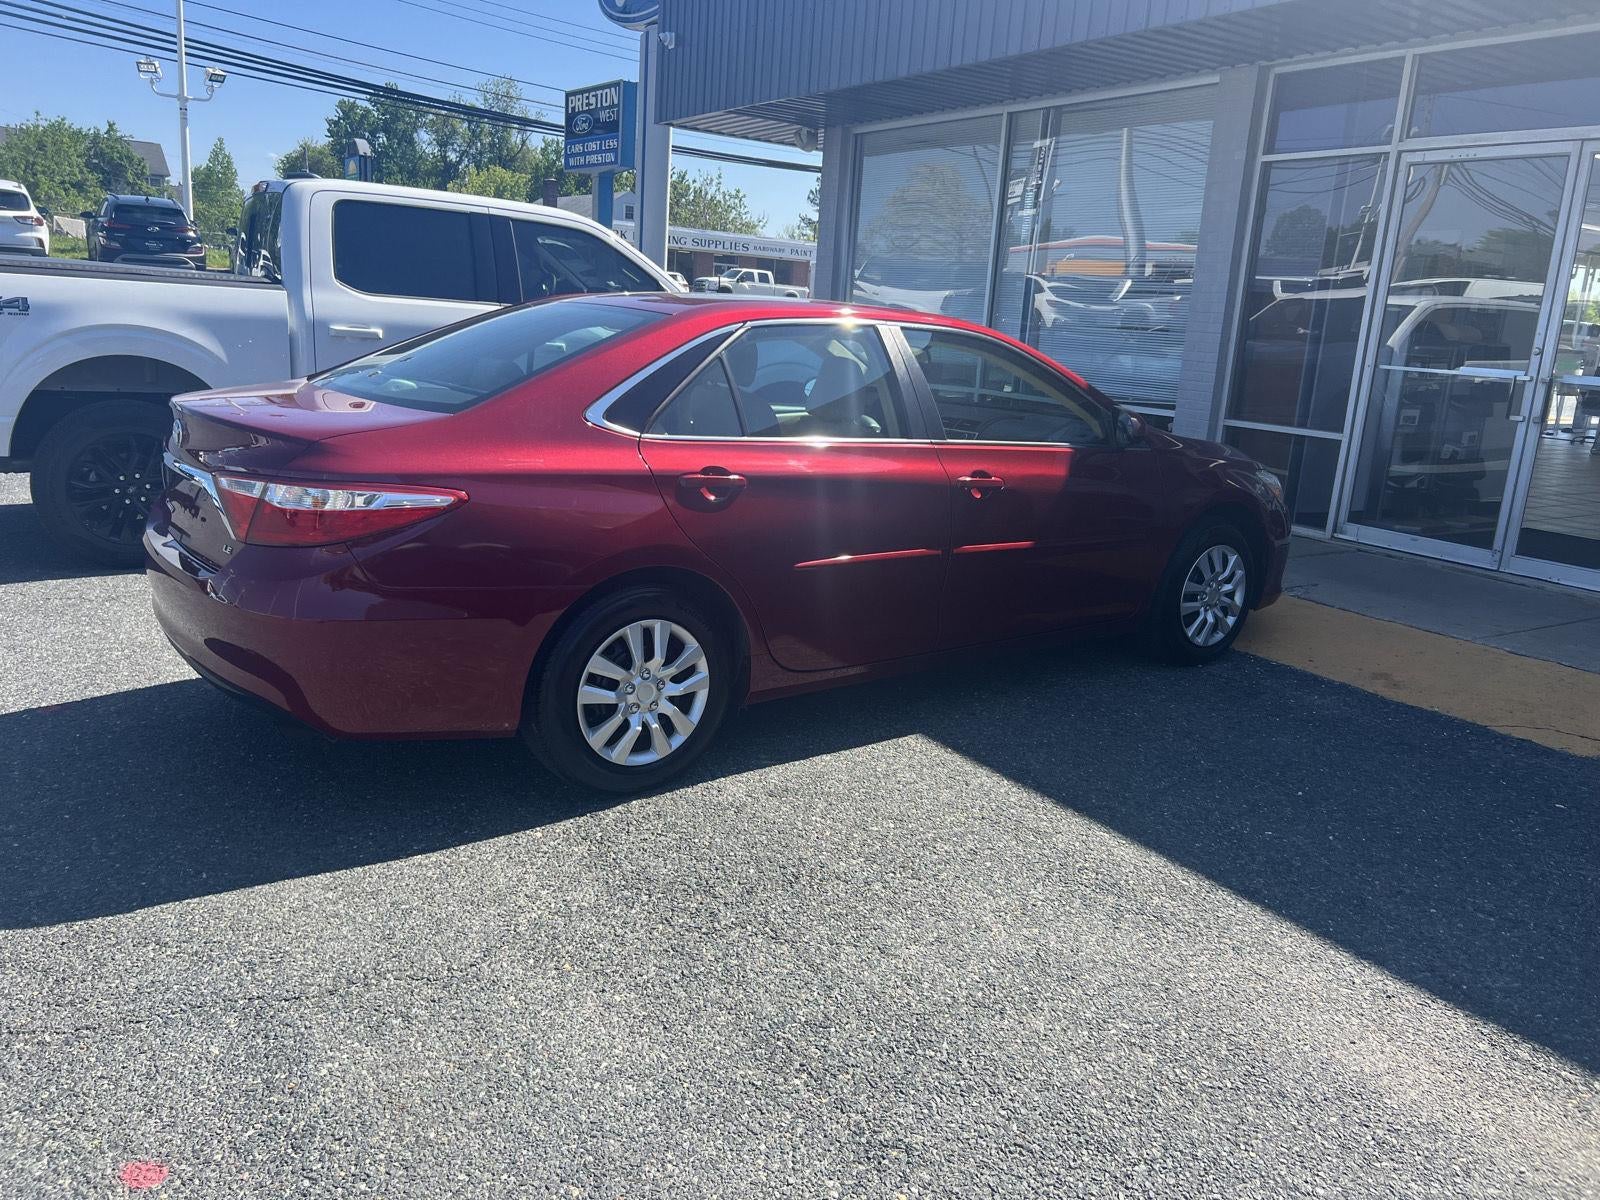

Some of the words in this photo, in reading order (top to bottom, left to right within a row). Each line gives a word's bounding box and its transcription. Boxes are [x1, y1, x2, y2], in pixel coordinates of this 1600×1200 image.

[568, 86, 619, 114] PRESTON
[600, 108, 618, 122] WEST
[567, 143, 583, 154] CARS
[584, 140, 601, 153] COST
[602, 138, 618, 150] LESS
[569, 155, 585, 167] WITH
[585, 152, 616, 165] PRESTON
[691, 237, 750, 252] SUPPLIES
[790, 248, 814, 258] PAINT
[0, 295, 30, 312] 4
[223, 544, 232, 554] LE
